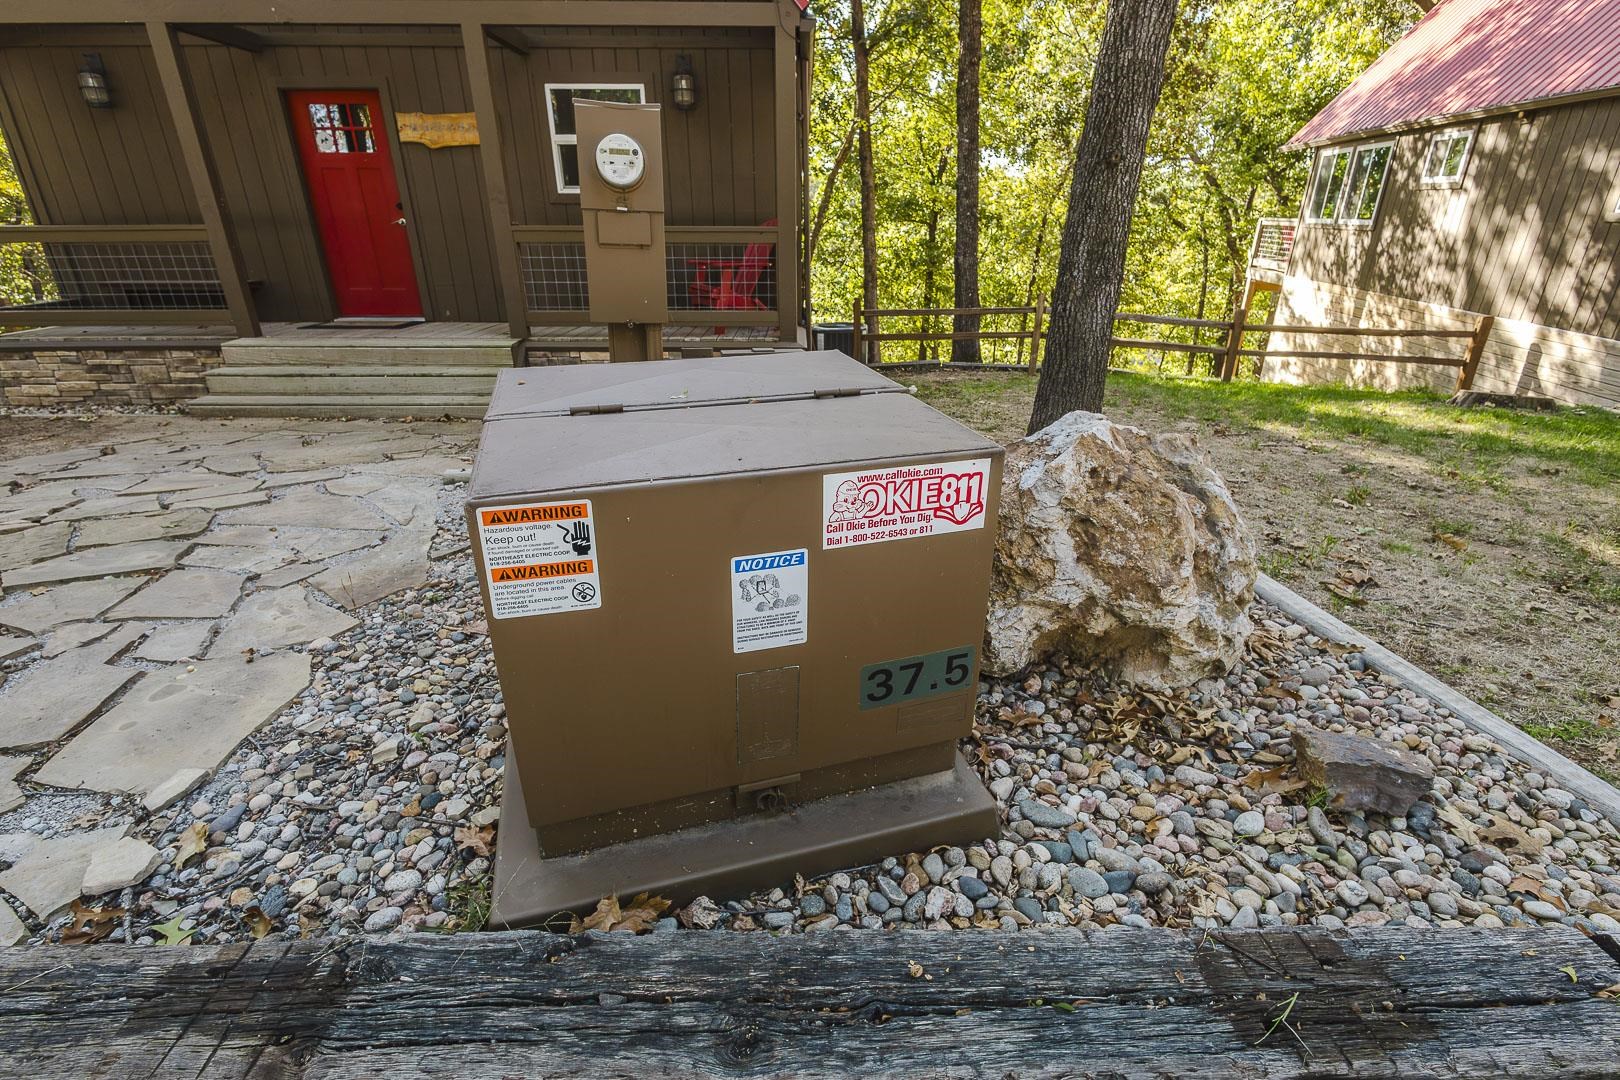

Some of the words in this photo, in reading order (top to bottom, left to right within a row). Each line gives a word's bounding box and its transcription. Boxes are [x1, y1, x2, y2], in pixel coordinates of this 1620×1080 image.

[857, 467, 943, 483] www.callokie.com
[503, 505, 582, 522] WARNING
[826, 522, 843, 534] Call
[846, 520, 865, 531] Okie
[868, 517, 897, 528] Before
[900, 515, 914, 525] You
[918, 514, 933, 523] Dig.
[485, 536, 513, 545] Keep
[517, 533, 536, 542] out!
[827, 536, 842, 545] Dial
[845, 530, 907, 543] 1-800-522-6543
[920, 525, 933, 534] 811
[512, 562, 587, 579] WARNING
[739, 554, 801, 571] NOTICE
[866, 653, 969, 702] 37.5
